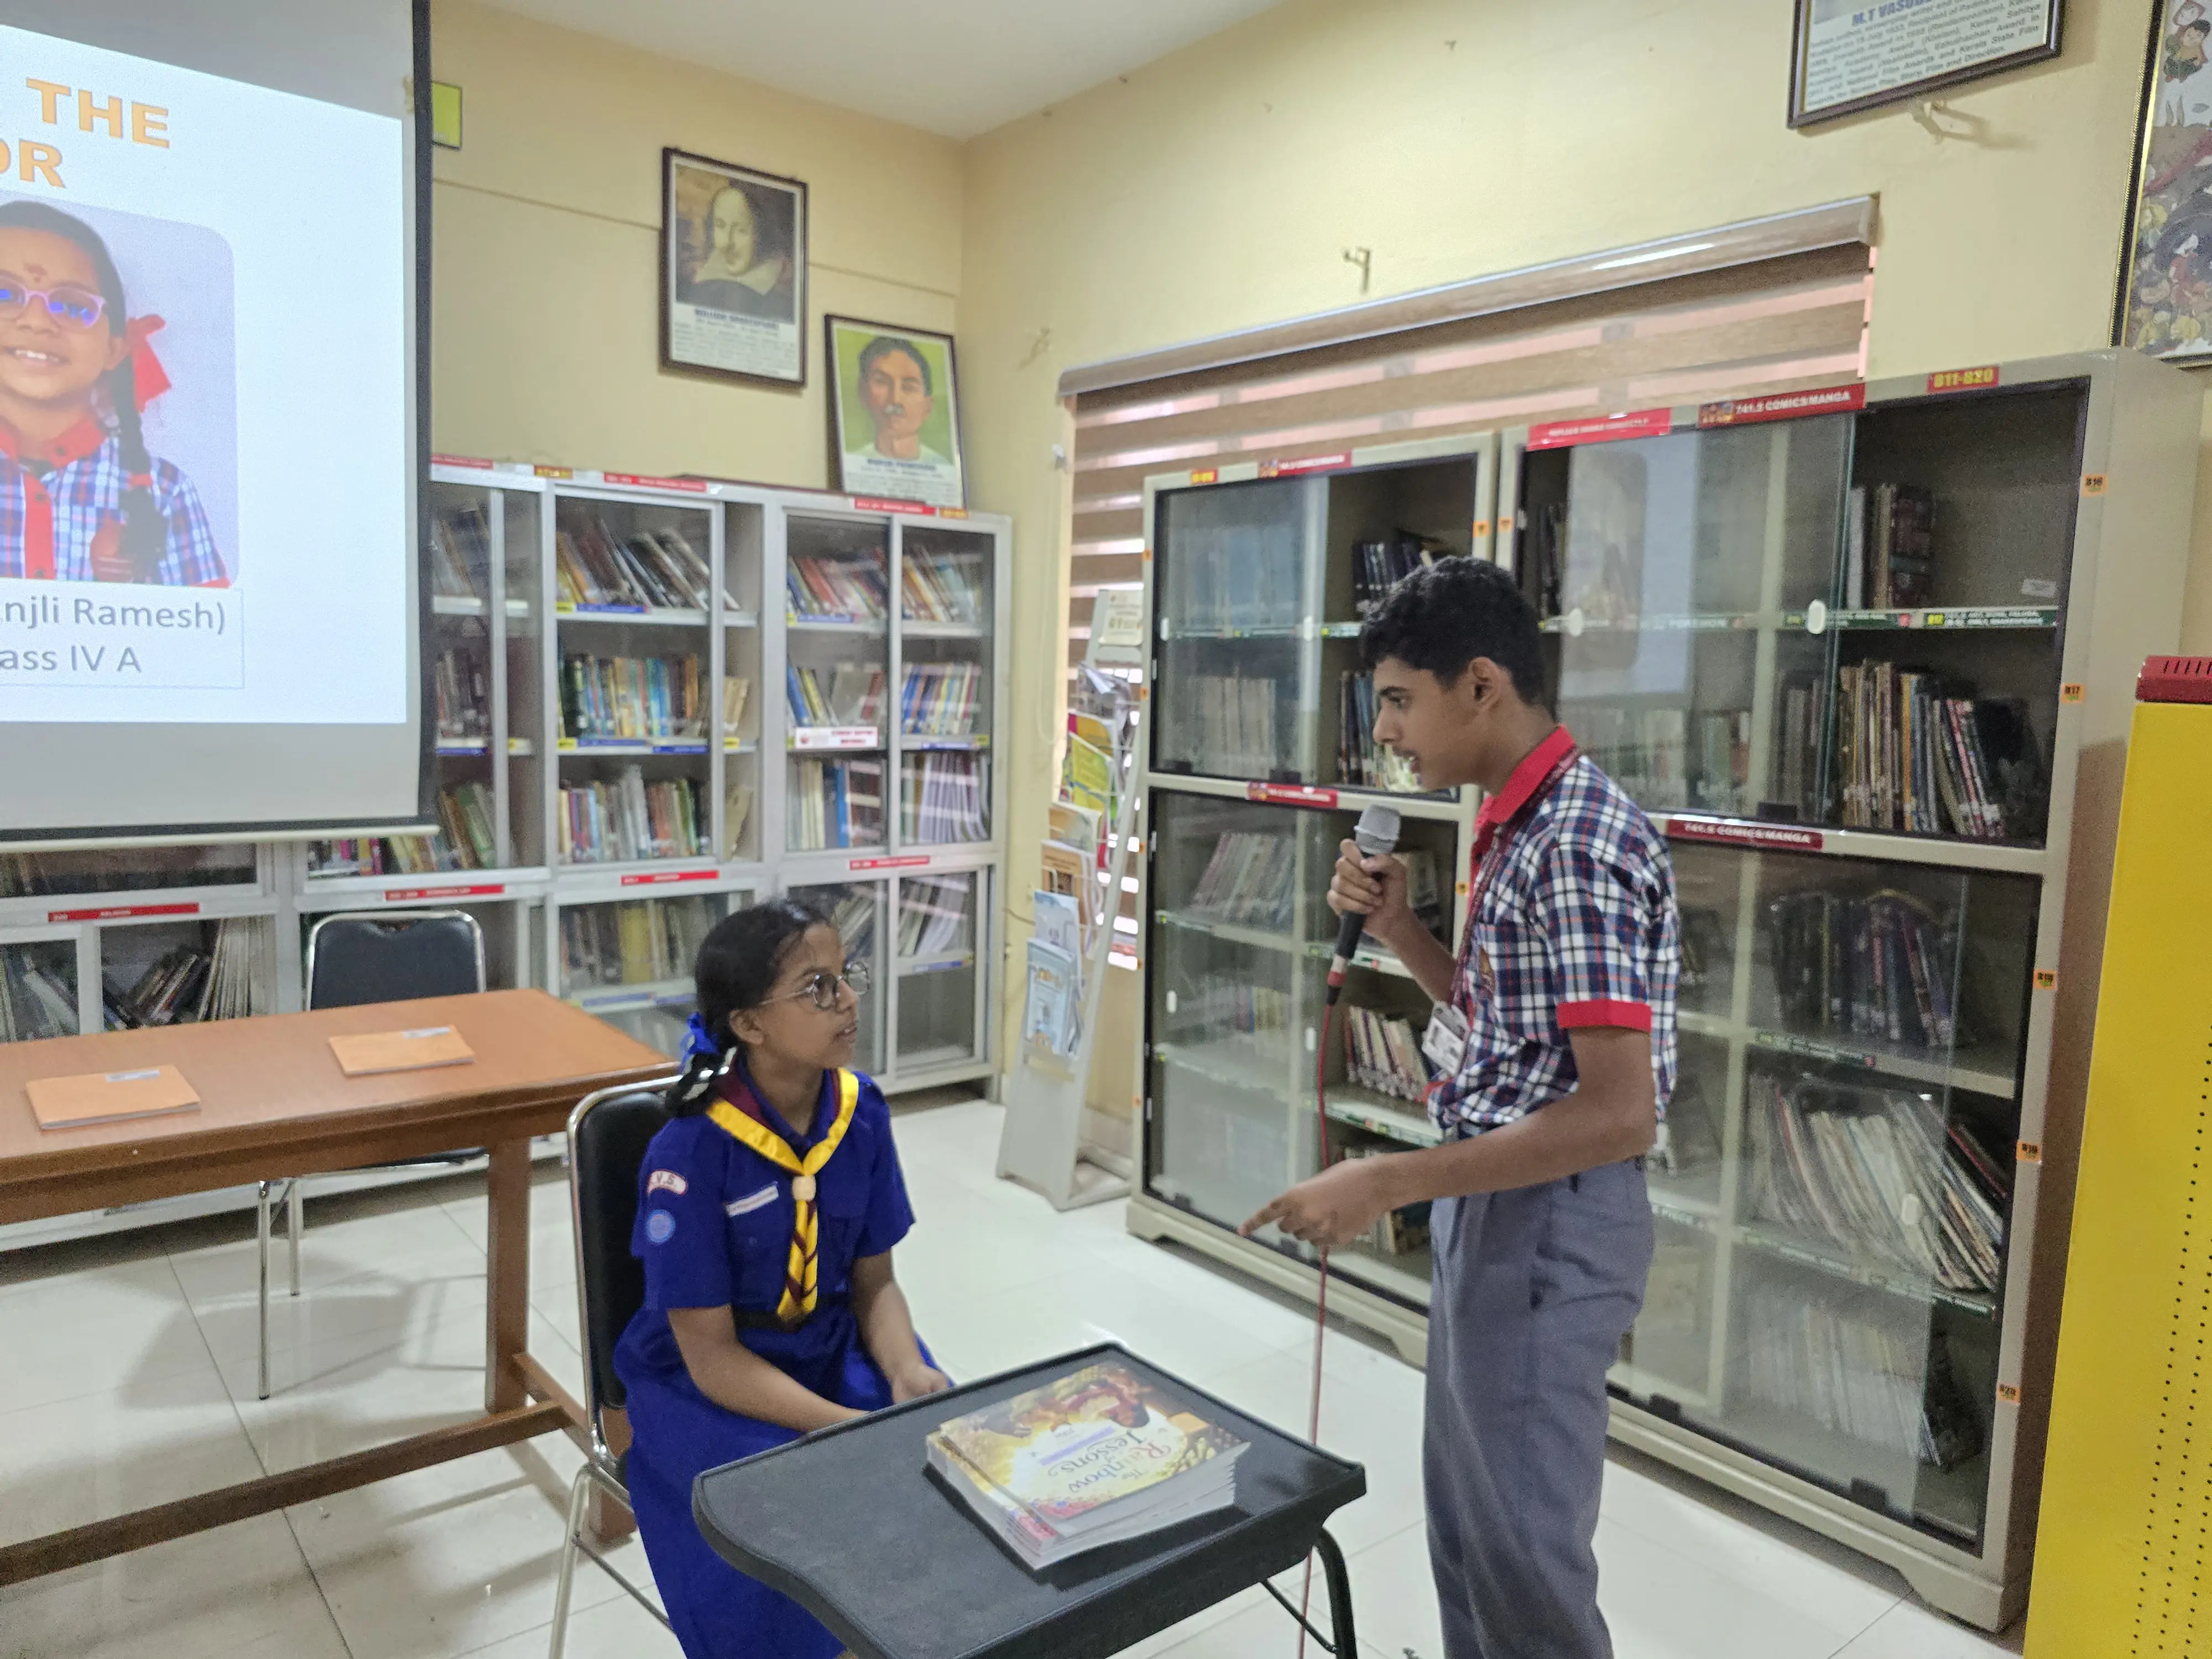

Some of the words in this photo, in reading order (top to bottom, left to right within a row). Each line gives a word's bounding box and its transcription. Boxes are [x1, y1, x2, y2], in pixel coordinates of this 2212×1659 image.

[25, 77, 170, 149] THE
[0, 594, 60, 629] njli
[74, 598, 226, 635] Ramesh)
[71, 645, 106, 671] IV
[116, 646, 142, 672] A
